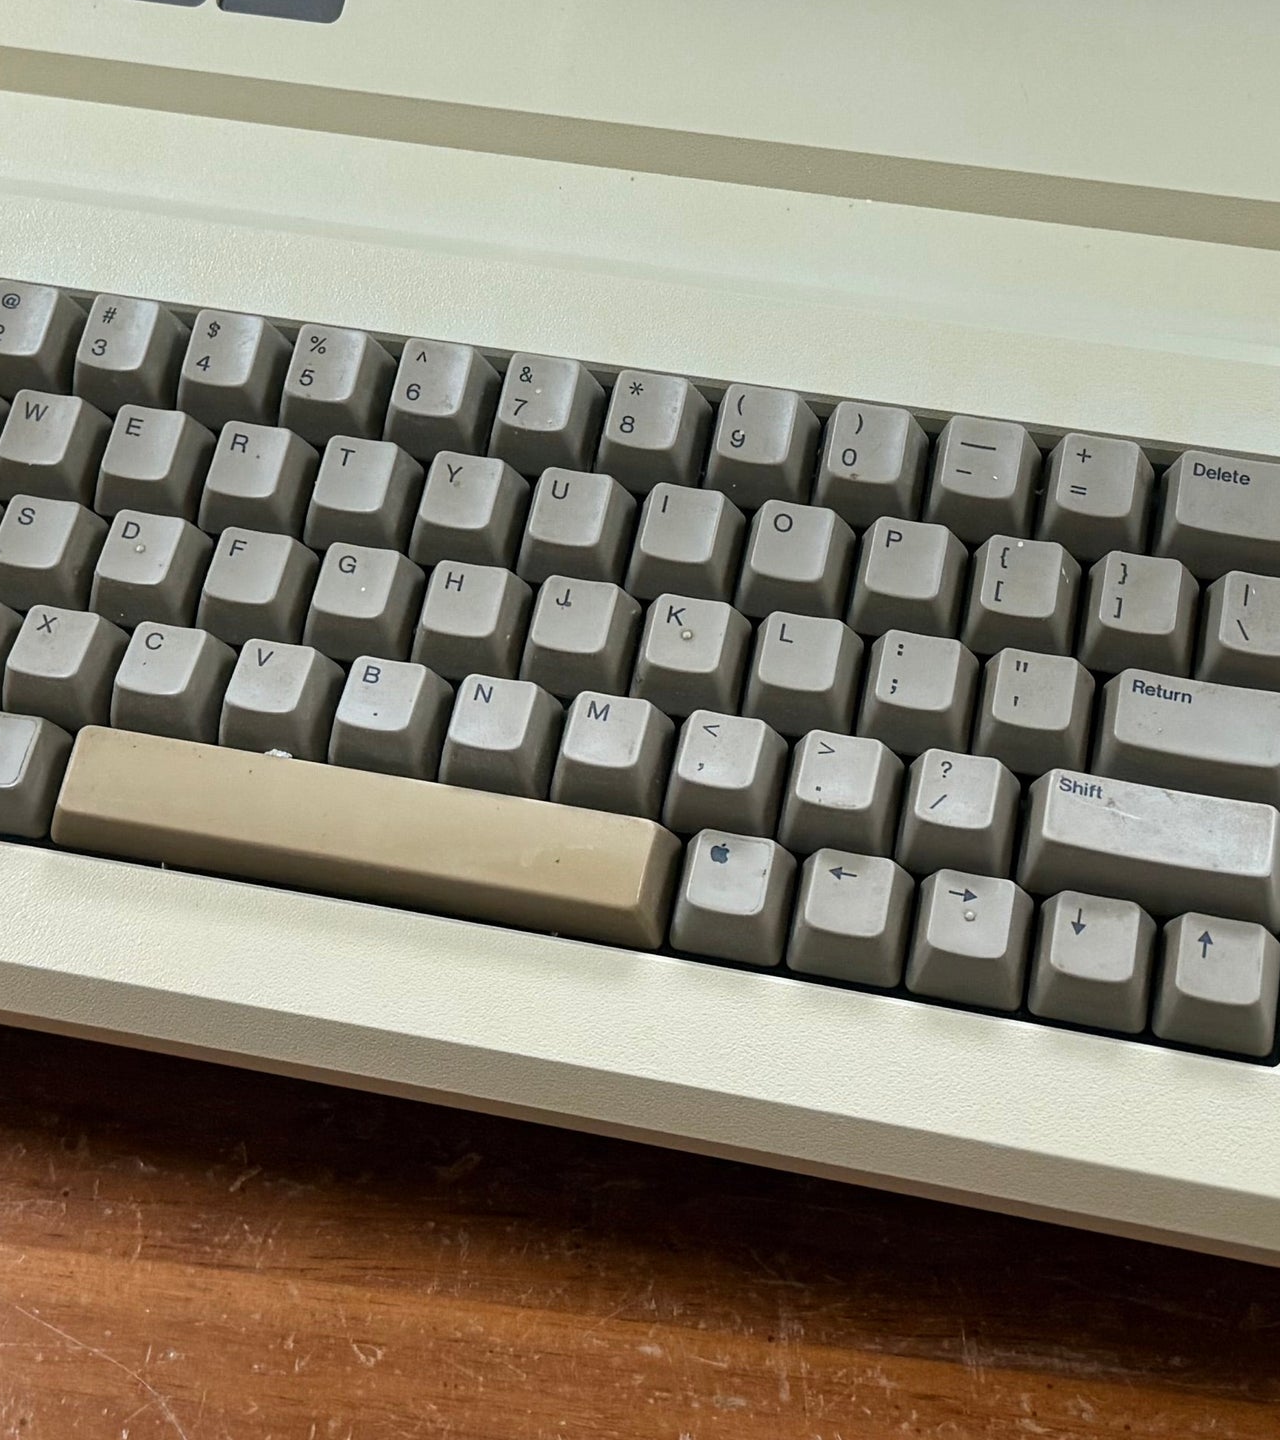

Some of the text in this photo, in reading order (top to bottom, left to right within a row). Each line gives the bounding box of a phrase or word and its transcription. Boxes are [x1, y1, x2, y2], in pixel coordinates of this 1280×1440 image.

[91, 338, 108, 357] 3
[195, 355, 211, 372] 4
[298, 368, 315, 387] 5
[406, 383, 421, 401] 6
[25, 400, 49, 422] W
[513, 398, 529, 416] 7
[125, 417, 144, 437] E
[619, 415, 635, 434] 8
[230, 432, 249, 454] R
[729, 429, 746, 449] 9
[340, 447, 356, 467] T
[841, 448, 858, 467] 0
[446, 463, 463, 483] Y
[1193, 462, 1251, 486] Delete
[551, 479, 570, 500] U
[17, 507, 36, 526] S
[773, 513, 793, 533] O
[121, 520, 141, 540] D
[885, 529, 903, 548] P
[229, 539, 248, 557] F
[338, 555, 357, 574] G
[444, 571, 465, 592] H
[555, 588, 572, 607] J
[36, 613, 58, 634] X
[666, 605, 686, 627] K
[145, 632, 165, 651] C
[779, 623, 794, 644] L
[257, 647, 274, 667] V
[362, 665, 381, 684] B
[473, 683, 494, 704] N
[1132, 679, 1193, 704] Return
[586, 700, 611, 722] M
[1059, 775, 1104, 800] Shift
